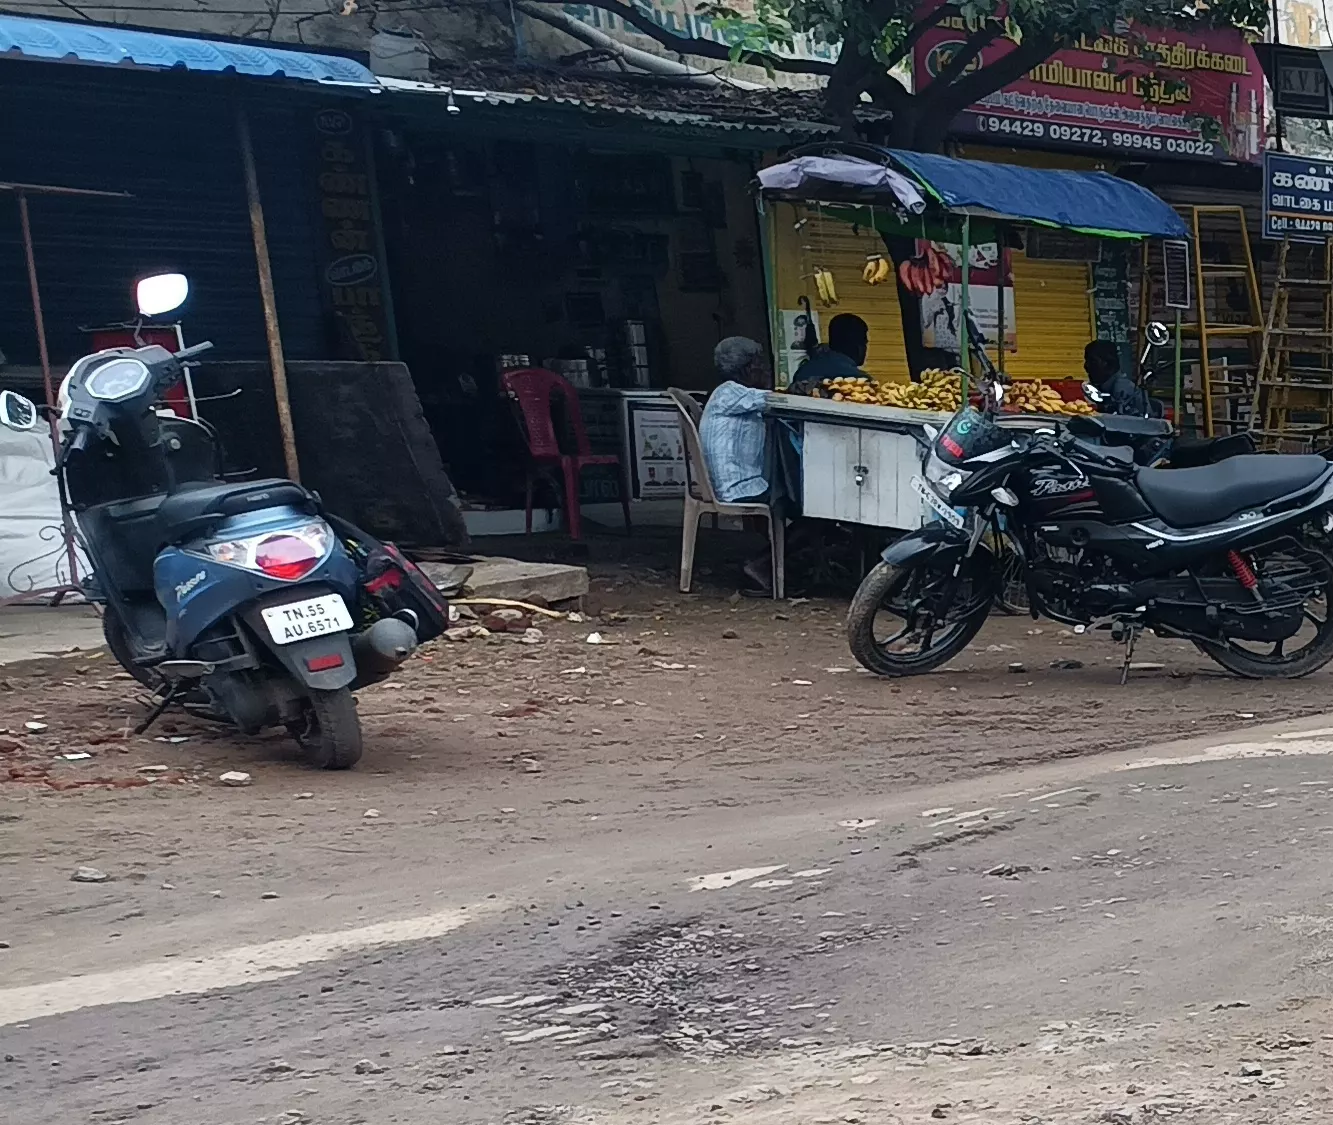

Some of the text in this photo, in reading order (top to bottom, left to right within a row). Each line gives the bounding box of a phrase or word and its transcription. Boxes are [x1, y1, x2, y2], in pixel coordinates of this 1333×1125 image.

[1282, 68, 1325, 93] KVP
[987, 117, 1214, 156] 94429 09272, 99945 03022
[1271, 193, 1321, 212] வாடகை
[282, 603, 326, 622] TN.55
[284, 616, 341, 639] AU.6571
